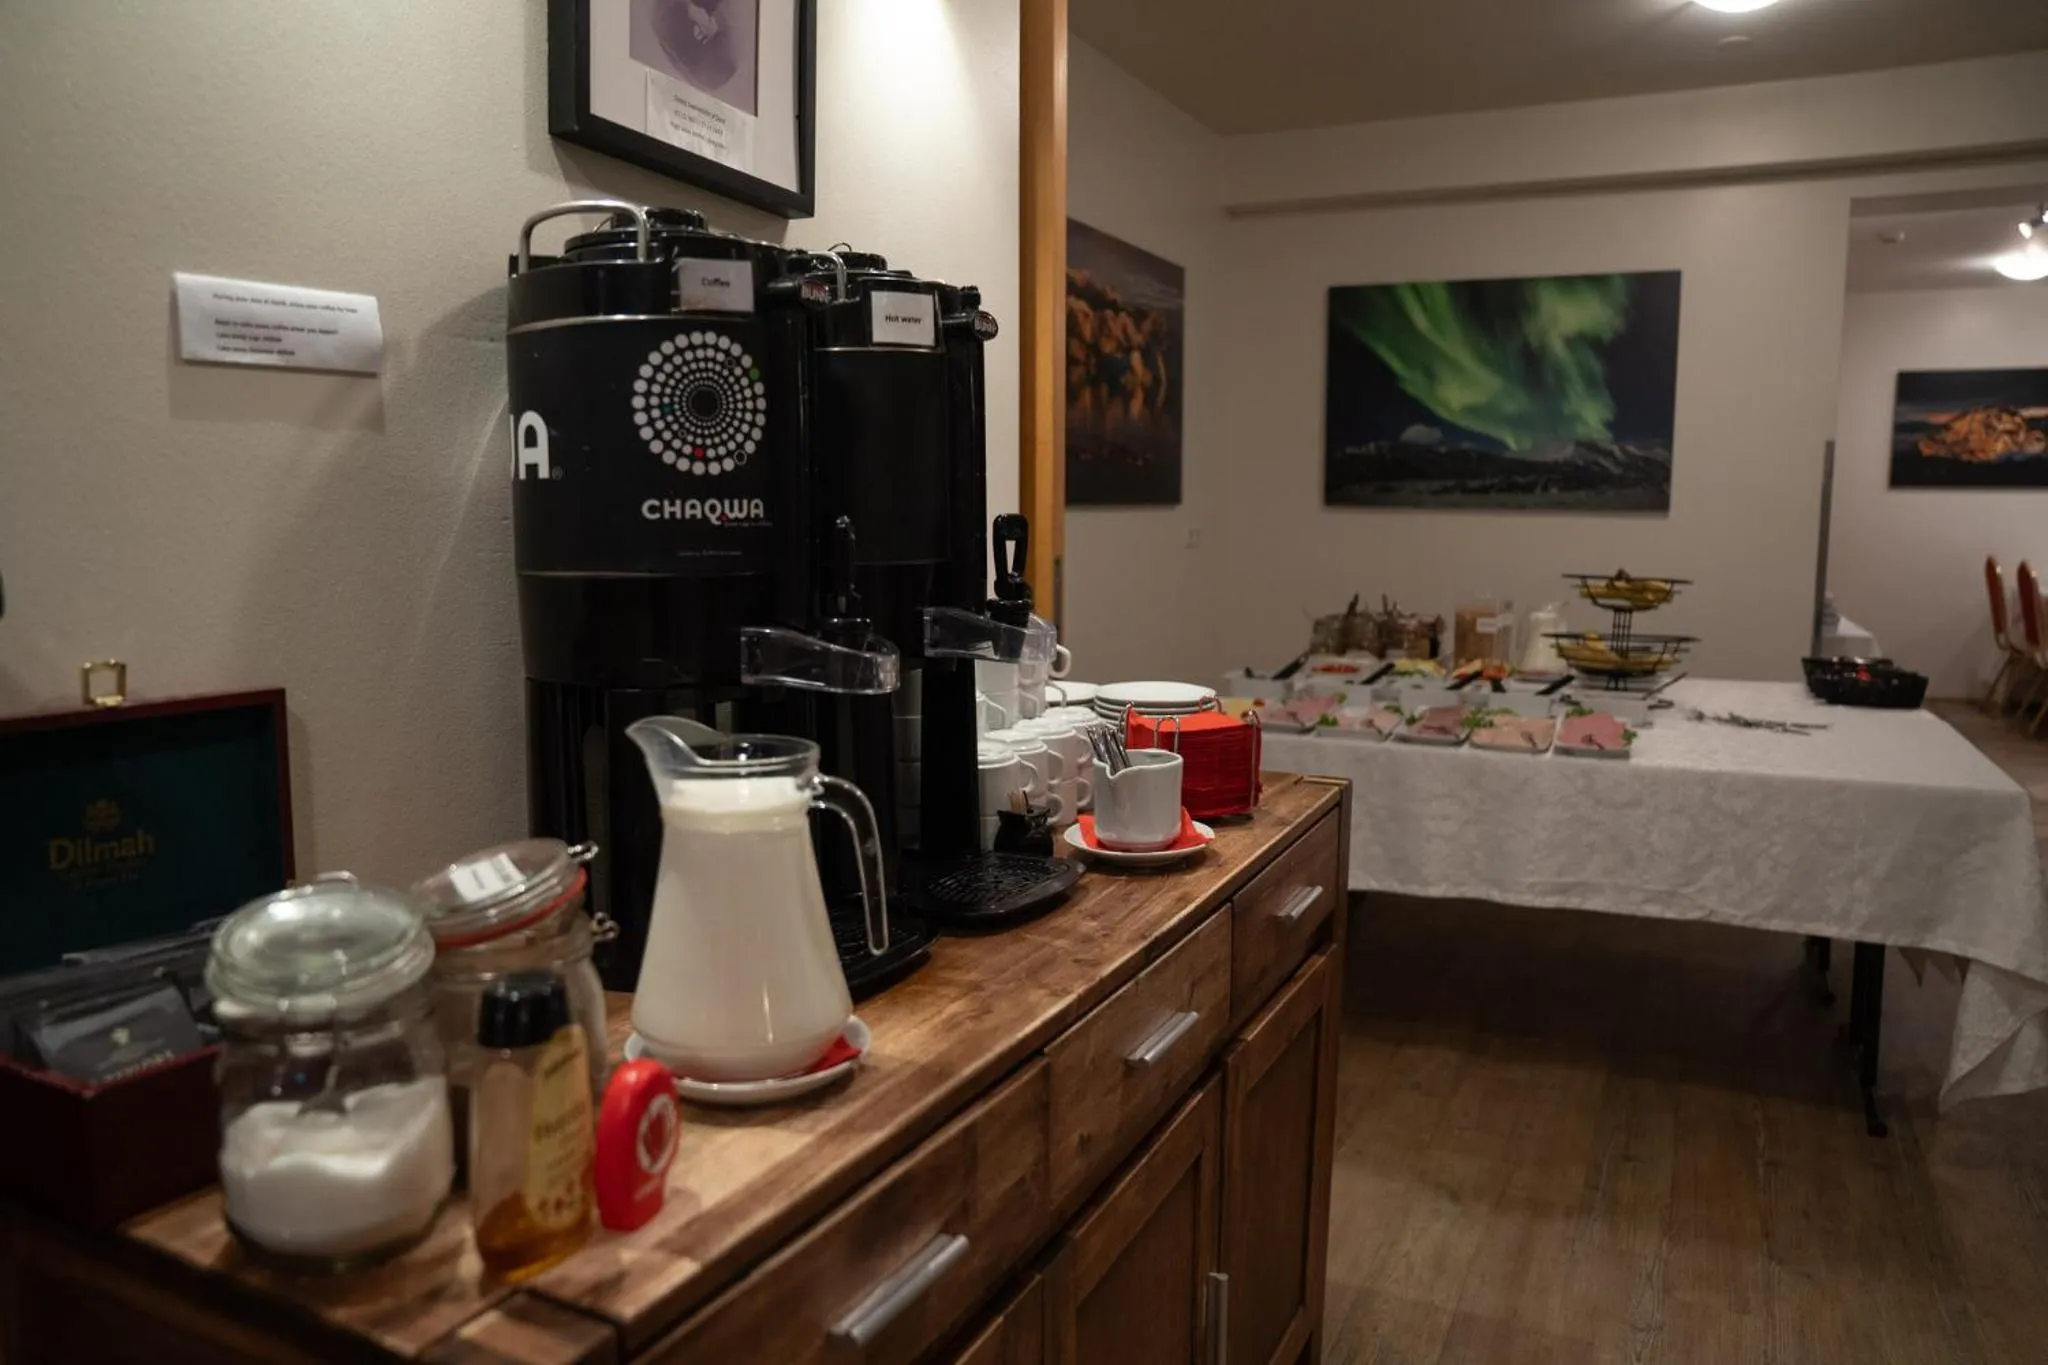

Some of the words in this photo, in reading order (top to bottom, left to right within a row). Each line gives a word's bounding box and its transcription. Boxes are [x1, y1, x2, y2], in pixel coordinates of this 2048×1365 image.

[701, 277, 731, 288] Coffee
[885, 313, 899, 323] Hot
[901, 315, 922, 325] water
[640, 497, 765, 525] CHAQWA
[48, 828, 156, 870] Dilmah
